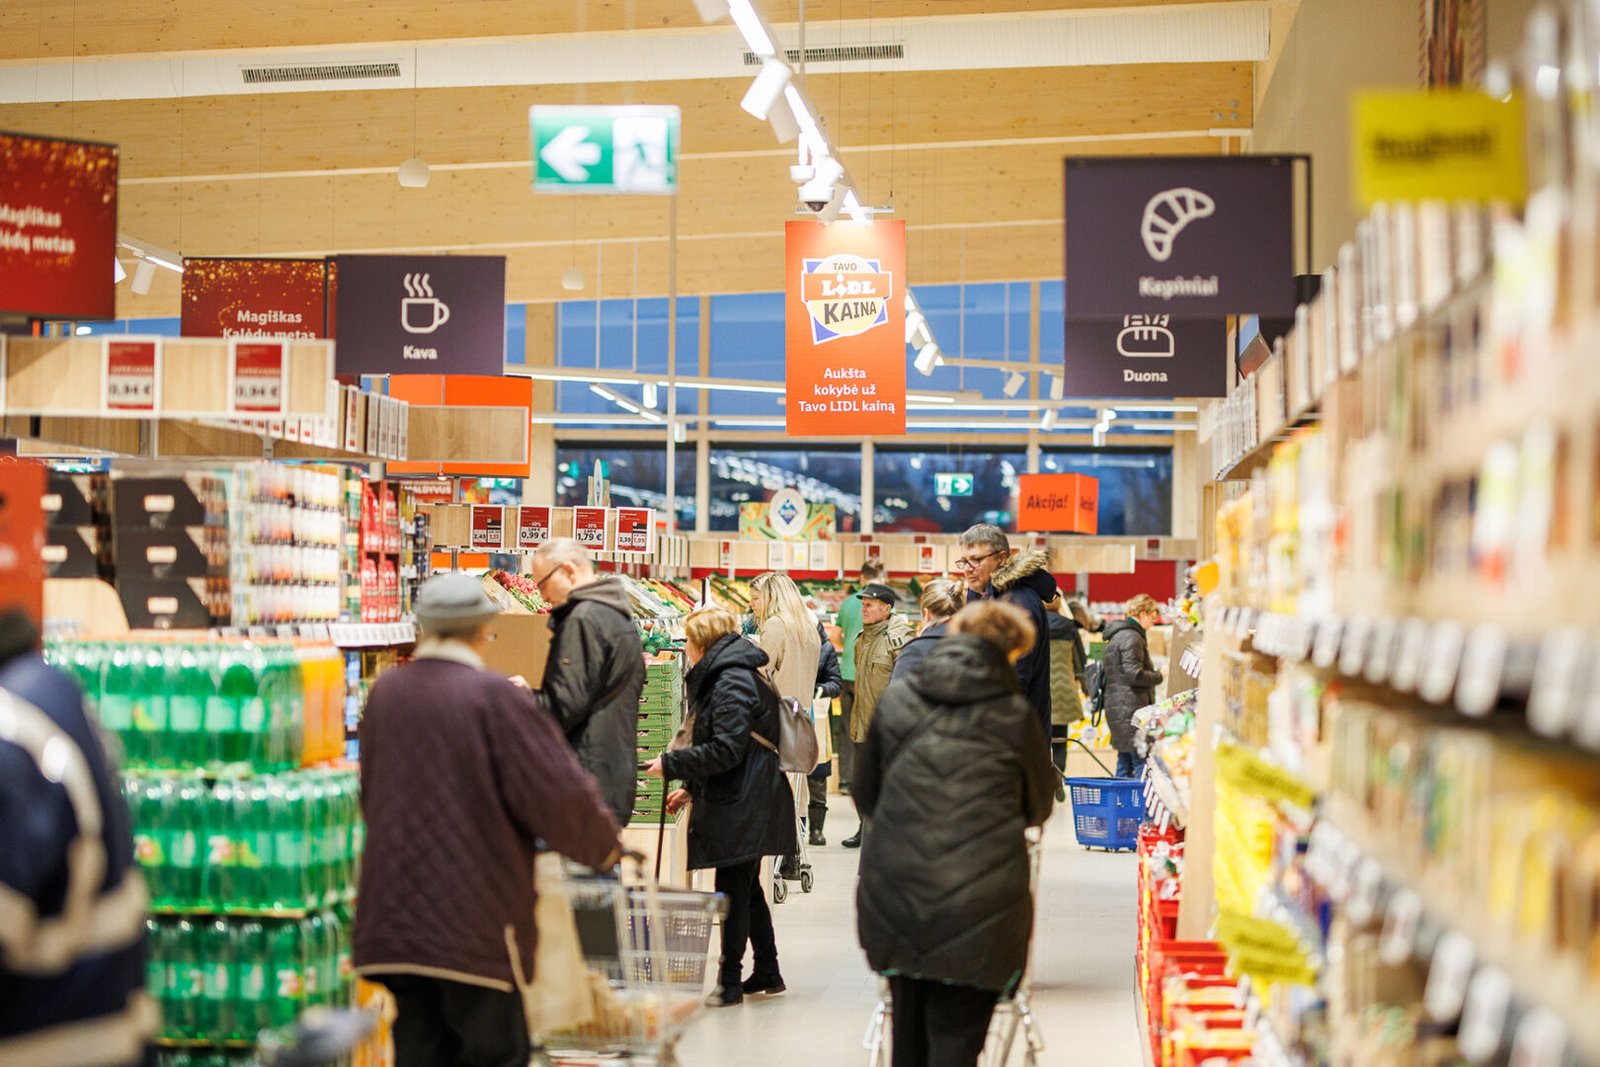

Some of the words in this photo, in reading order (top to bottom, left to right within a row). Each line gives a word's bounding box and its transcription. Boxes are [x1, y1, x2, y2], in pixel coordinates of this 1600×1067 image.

[833, 263, 858, 271] TAVO
[237, 309, 302, 325] Magiškas
[824, 301, 877, 325] KAINA
[274, 330, 316, 340] metas
[403, 345, 438, 360] Kava
[823, 368, 867, 379] Aukšta
[1123, 369, 1168, 382] Duona
[814, 384, 858, 397] kokybė
[861, 384, 877, 395] už
[798, 401, 827, 412] Tavo
[830, 401, 859, 412] LIDL
[862, 400, 896, 414] kainą
[1027, 493, 1068, 511] Akcija!
[521, 531, 539, 539] 0,99
[578, 533, 594, 542] 1,79
